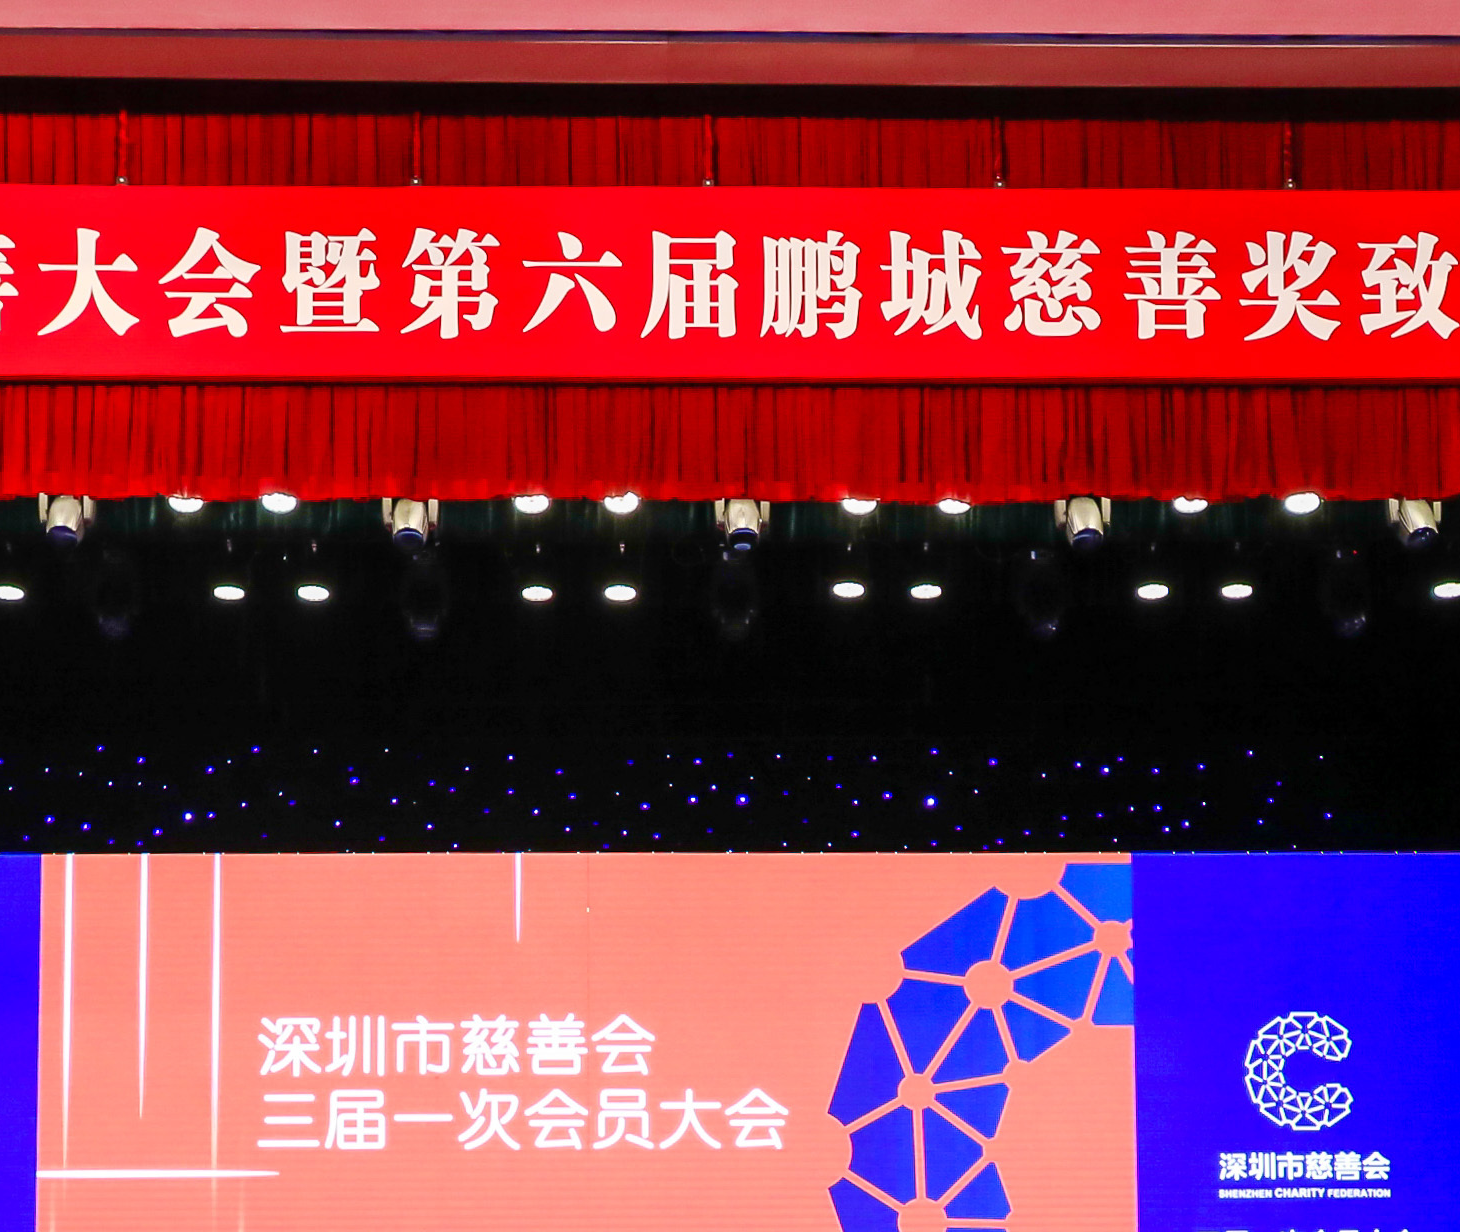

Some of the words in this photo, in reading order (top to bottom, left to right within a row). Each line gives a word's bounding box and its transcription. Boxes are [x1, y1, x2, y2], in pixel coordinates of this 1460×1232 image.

[257, 1012, 656, 1078] 深圳市慈善会
[256, 1087, 789, 1151] 三届一次会员大会
[1218, 1150, 1391, 1182] 深圳市慈善会
[1218, 1188, 1273, 1199] SHENZHEN
[1273, 1187, 1326, 1199] CHARITY
[1326, 1188, 1392, 1199] FEDERATION
